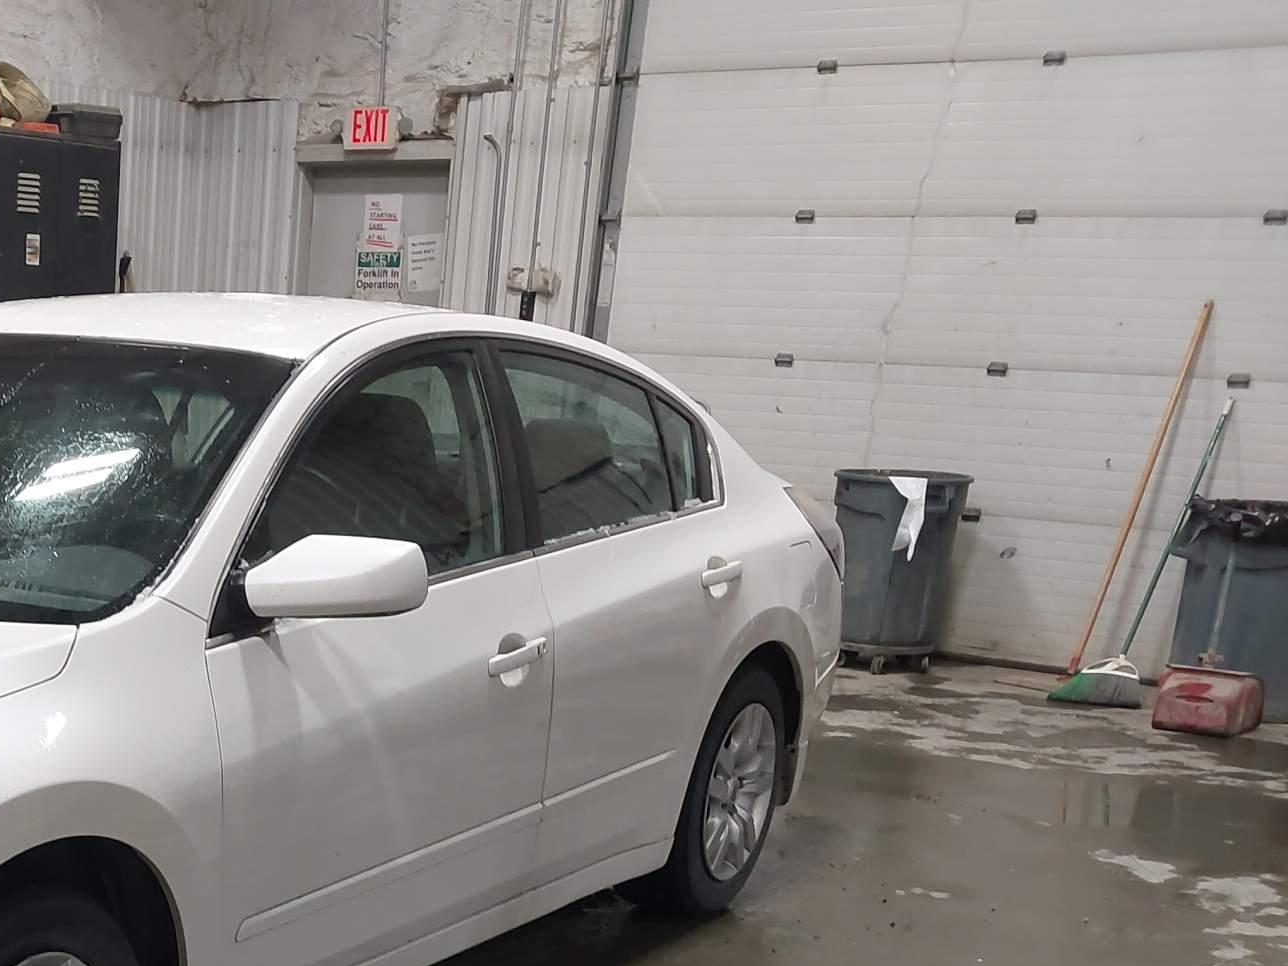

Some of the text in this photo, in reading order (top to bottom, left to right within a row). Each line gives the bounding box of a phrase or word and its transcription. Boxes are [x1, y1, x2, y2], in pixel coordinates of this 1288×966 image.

[352, 108, 389, 144] EXIT
[360, 252, 399, 263] SAFETY
[357, 268, 388, 278] Forklift
[356, 279, 399, 291] Operation
